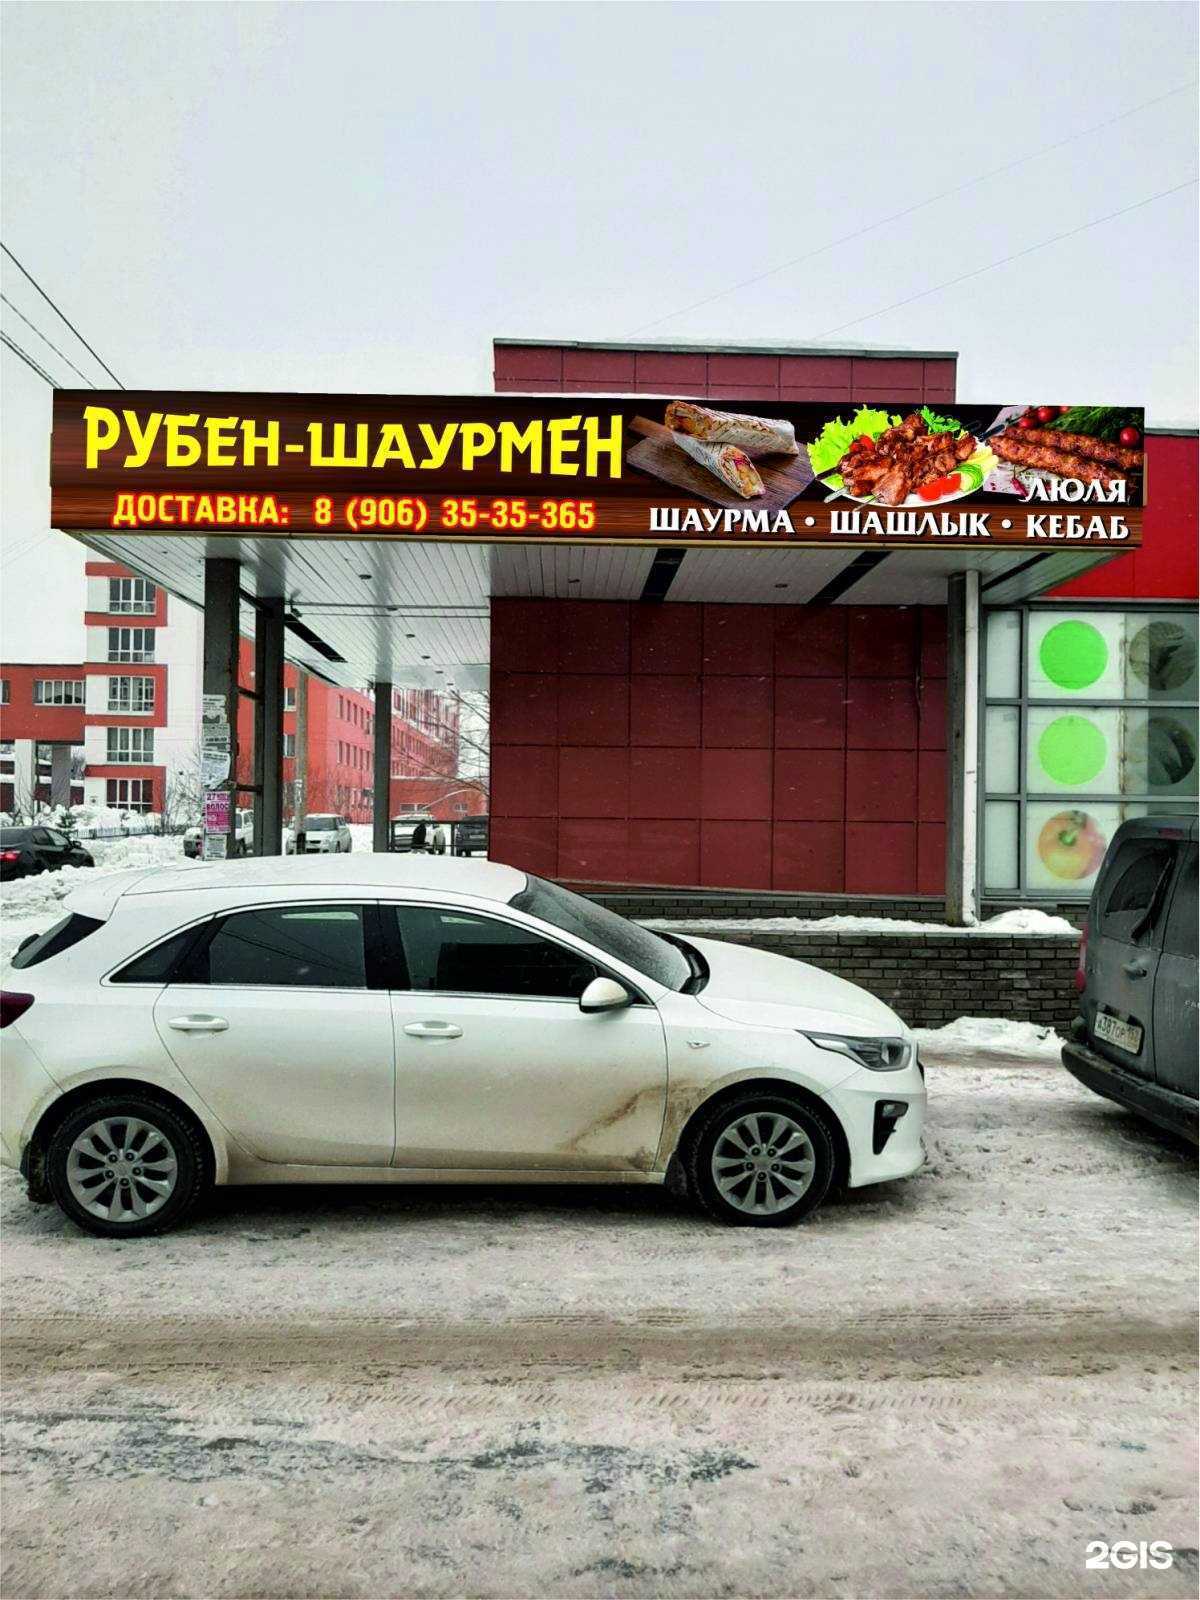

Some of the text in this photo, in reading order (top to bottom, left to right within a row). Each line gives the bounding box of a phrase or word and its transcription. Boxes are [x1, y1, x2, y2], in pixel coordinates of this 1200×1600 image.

[83, 405, 623, 479] РУБЕН-ШАУРМЕН
[1023, 477, 1127, 503] ЛЮЛЯ
[112, 493, 597, 531] ДОСТАВКА: 8 (906) 35-35-365
[649, 507, 1130, 540] ШАУРМА ШАШЛЫК КЕБАБ
